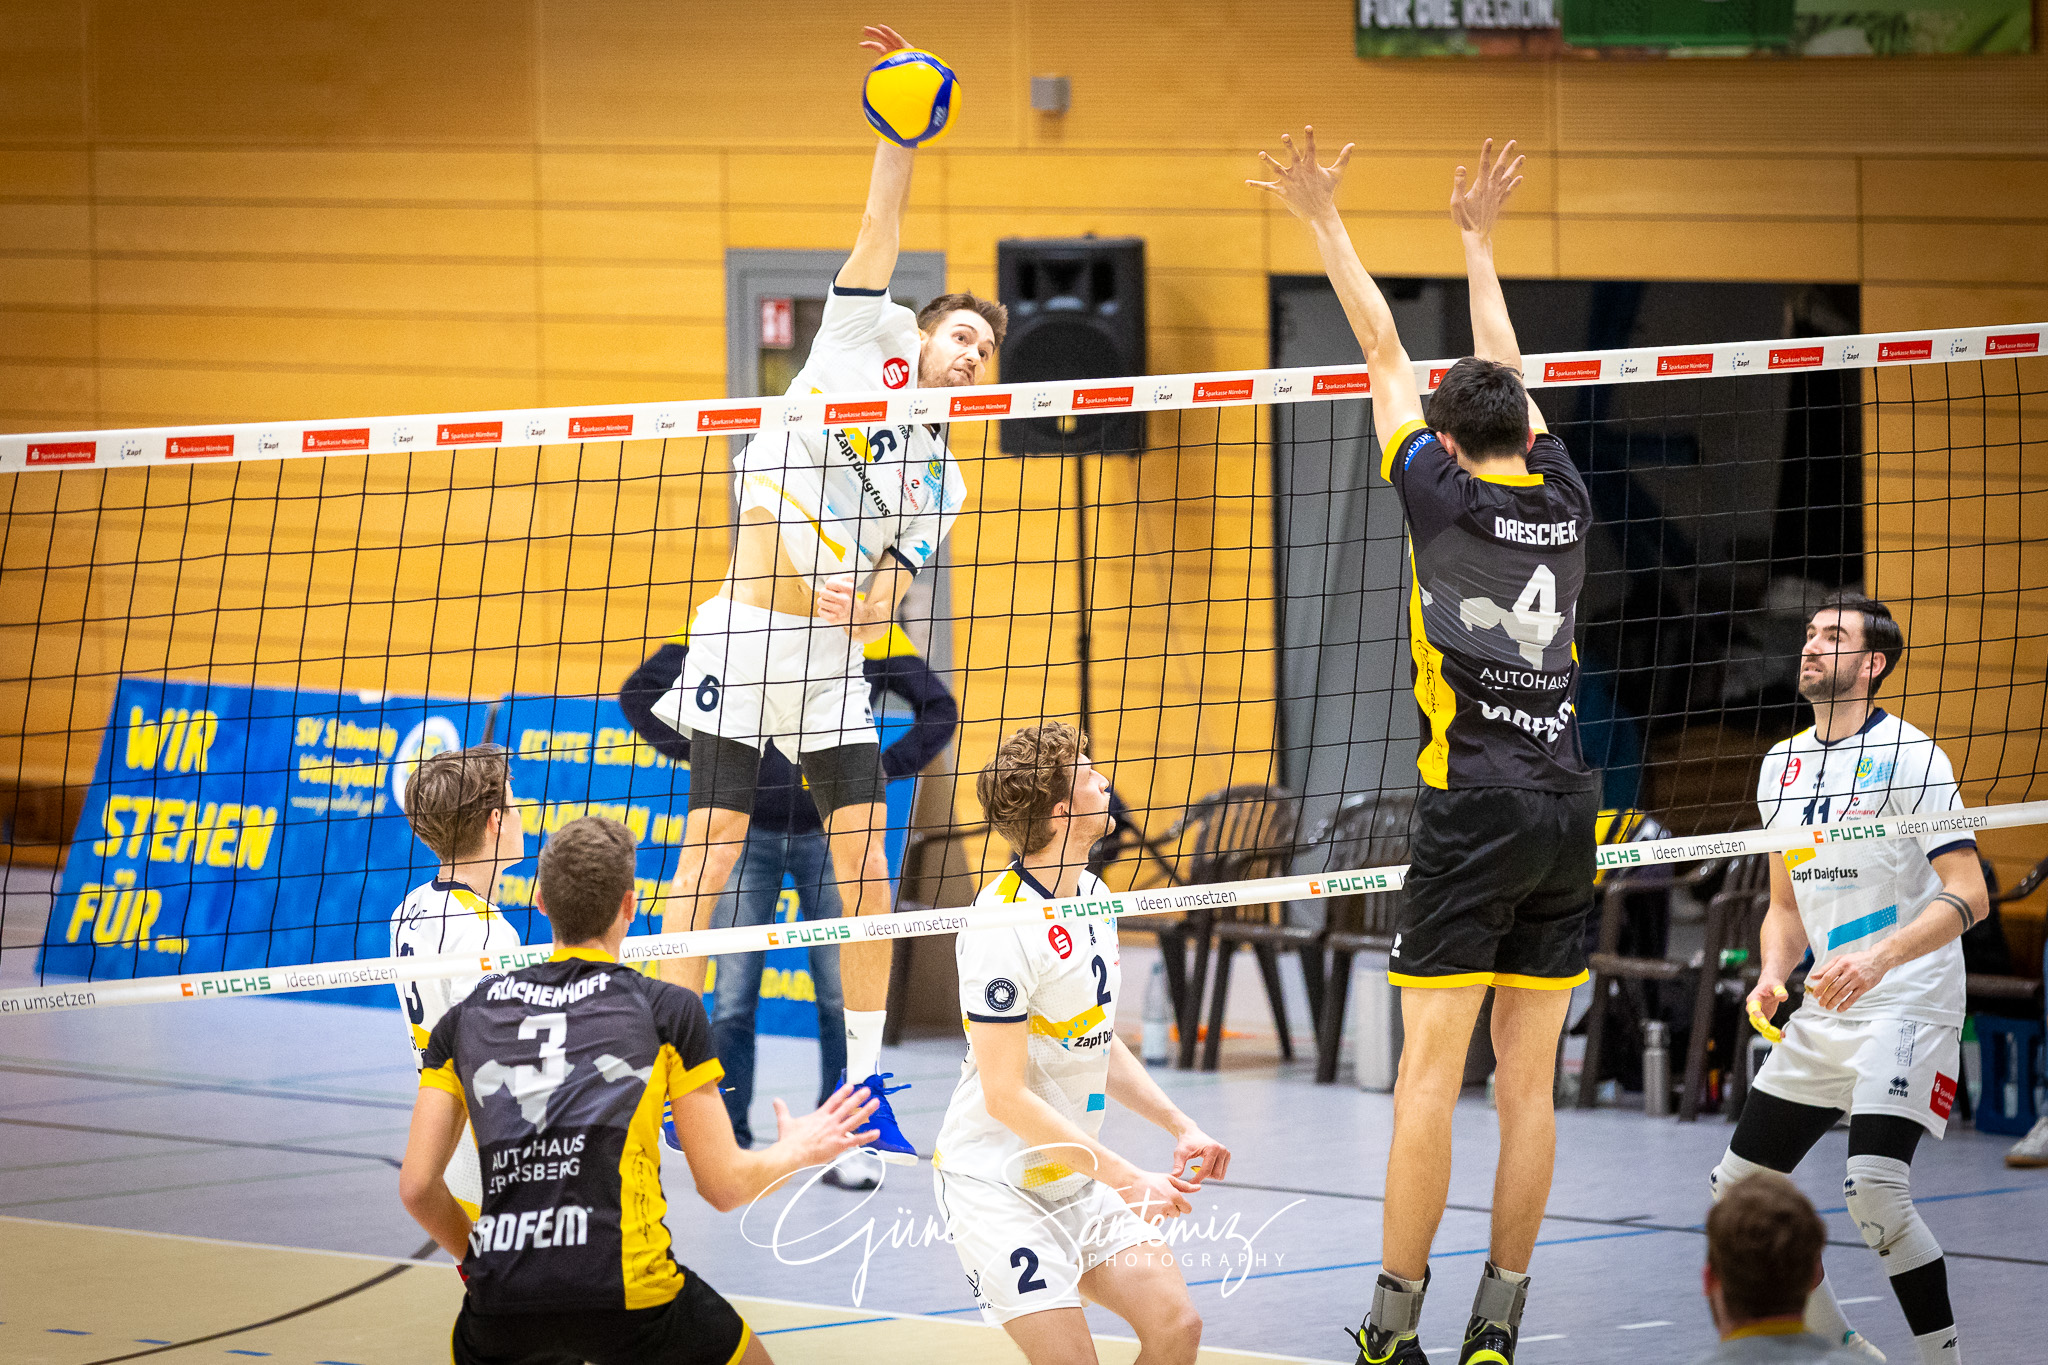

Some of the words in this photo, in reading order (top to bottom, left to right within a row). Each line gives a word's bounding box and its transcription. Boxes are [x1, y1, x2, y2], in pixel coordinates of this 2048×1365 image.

[67, 451, 91, 459] Nürnberg
[206, 444, 229, 452] Nürnberg
[264, 442, 279, 450] Zapf
[834, 429, 858, 465] Zapf
[1495, 516, 1578, 546] DRESCHER
[1511, 563, 1562, 642] 4
[695, 674, 720, 712] 6
[125, 705, 218, 772] WIR
[1802, 797, 1831, 826] 11
[93, 794, 278, 870] STEHEN
[1829, 824, 1886, 842] FUCHS
[1896, 821, 1929, 835] Ideen
[1933, 815, 1988, 832] umsetzen
[1596, 849, 1641, 866] UCHS
[1651, 846, 1685, 860] Ideen
[1690, 840, 1746, 856] umsetzen
[1326, 875, 1387, 893] FUCHS
[1791, 868, 1812, 883] Zapf
[1815, 867, 1858, 882] Daigfuss
[1061, 900, 1124, 918] FUCHS
[1135, 897, 1172, 911] Ideen
[1175, 891, 1237, 908] umsetzen
[787, 925, 850, 944] FUCHS
[863, 922, 900, 937] Ideen
[904, 916, 968, 933] umsetzen
[499, 952, 551, 969] FUCH
[622, 942, 688, 959] umsetzen
[202, 976, 271, 996] FUCHS
[284, 973, 326, 988] Ideen
[330, 967, 398, 984] umsetzen
[1091, 954, 1112, 1007] 2
[24, 992, 96, 1012] umsetzen
[1074, 1036, 1102, 1049] Zapf
[517, 1012, 567, 1097] 3
[1010, 1247, 1048, 1294] 2
